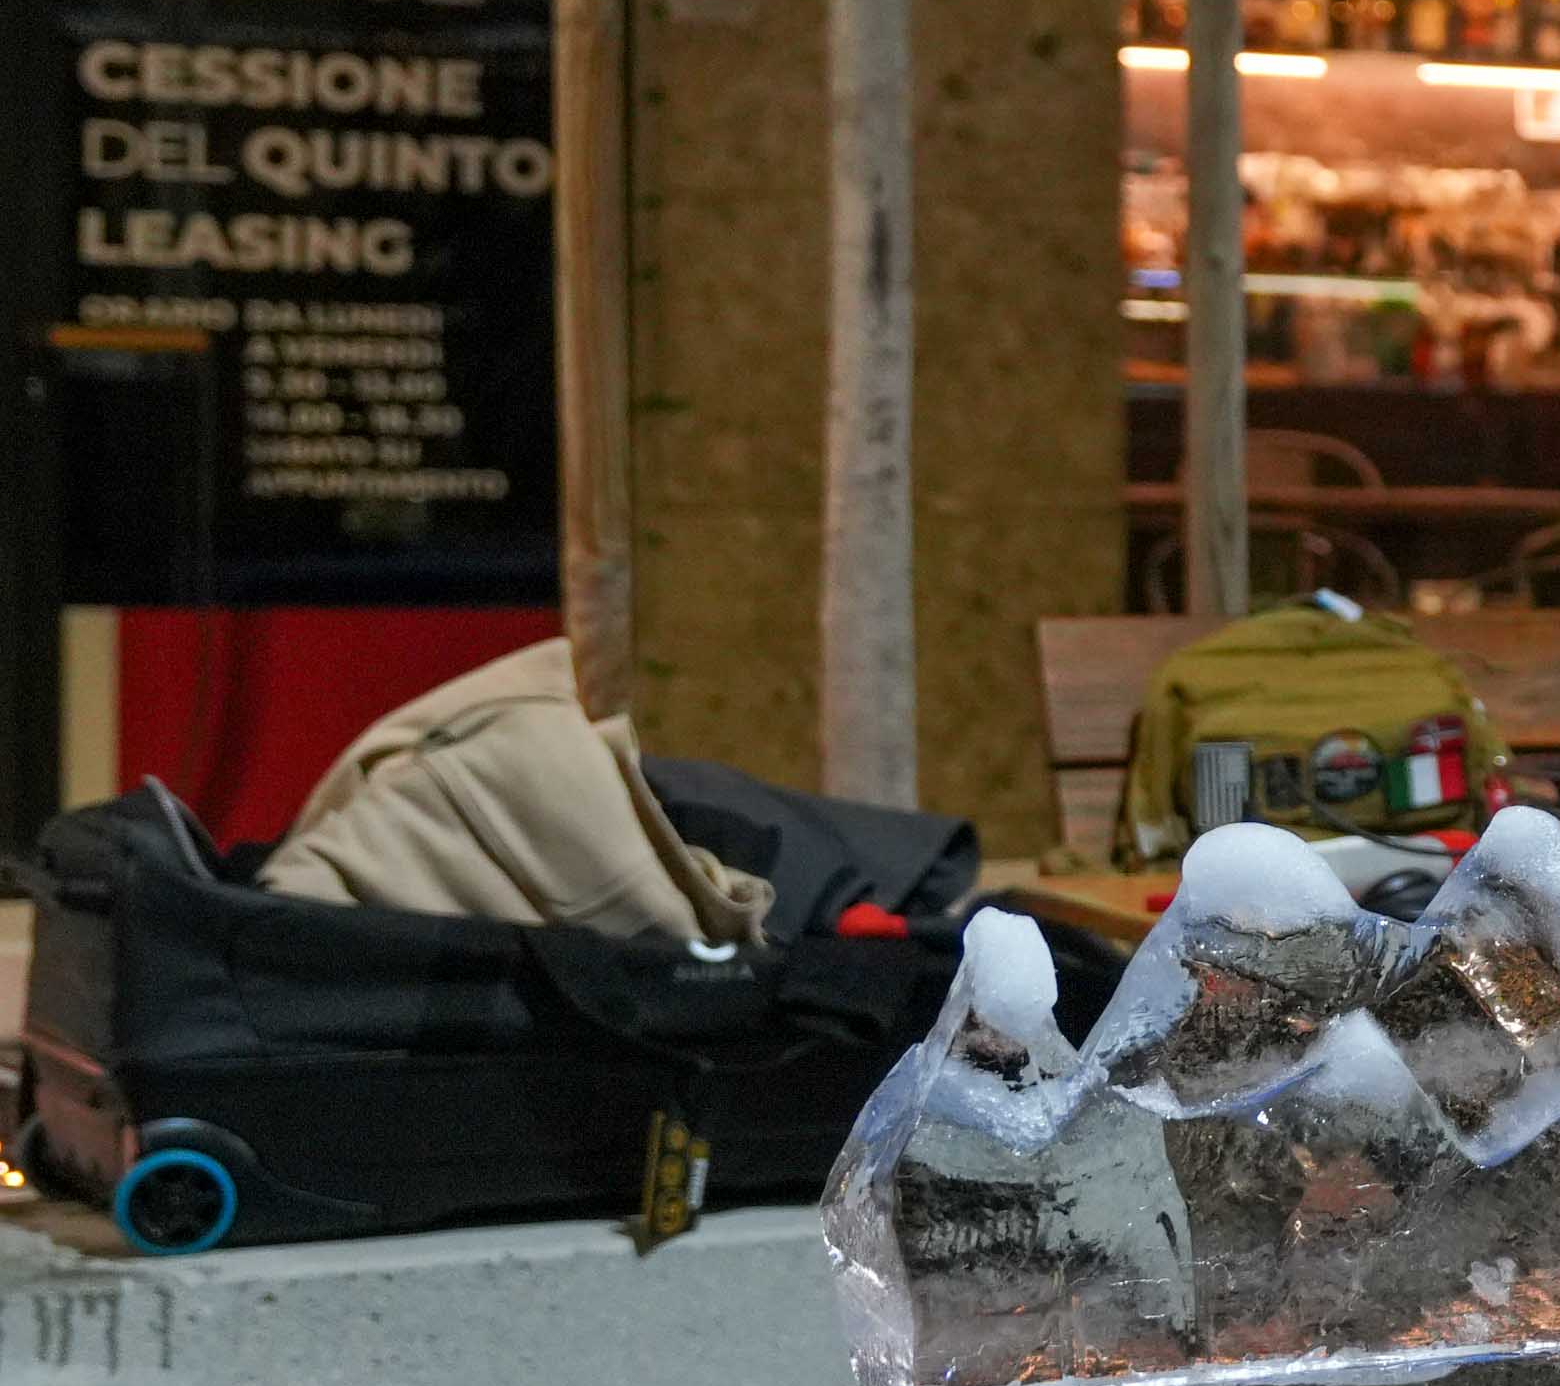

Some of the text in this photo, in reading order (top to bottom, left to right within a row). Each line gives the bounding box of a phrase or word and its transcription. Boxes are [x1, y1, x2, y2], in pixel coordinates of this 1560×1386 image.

[77, 38, 485, 116] CESSIONE
[81, 116, 553, 198] DEL QUINTO
[77, 206, 416, 276] LEASING
